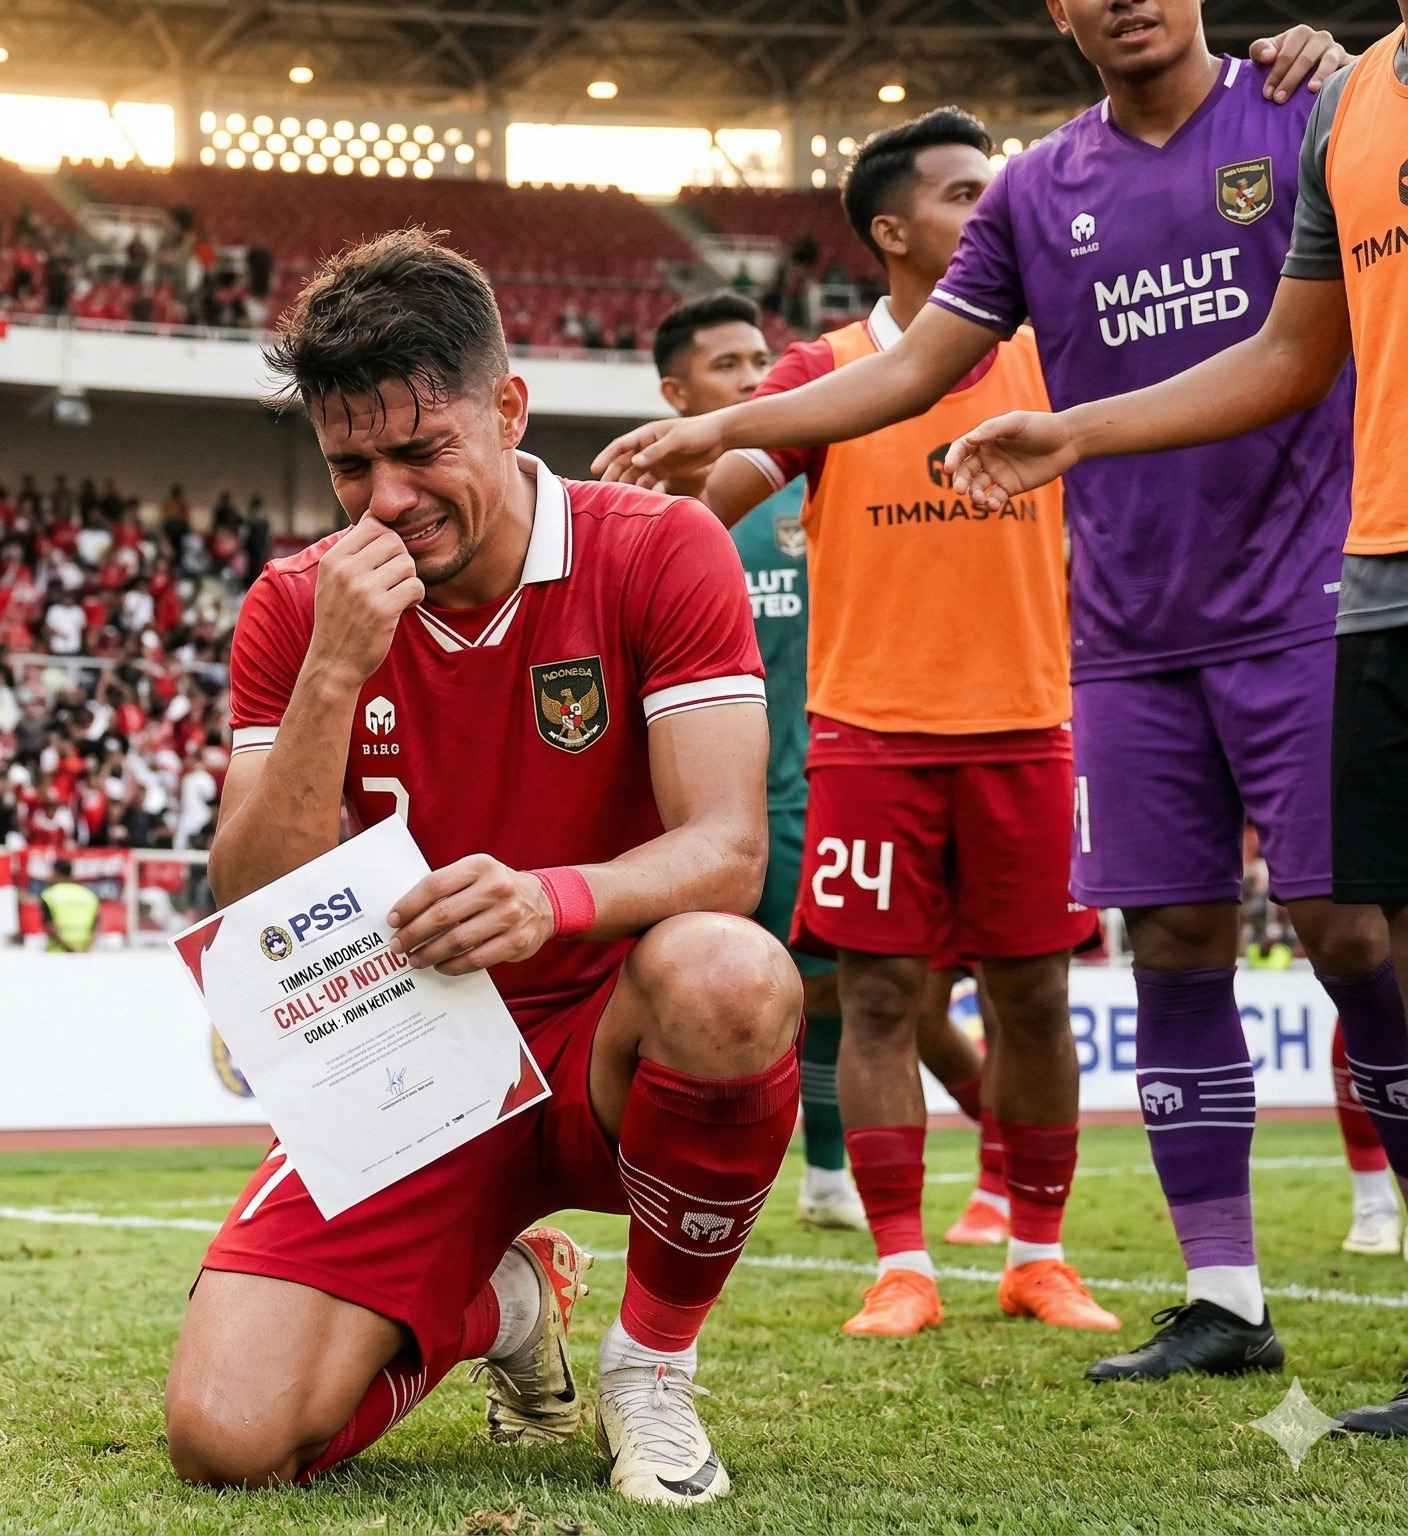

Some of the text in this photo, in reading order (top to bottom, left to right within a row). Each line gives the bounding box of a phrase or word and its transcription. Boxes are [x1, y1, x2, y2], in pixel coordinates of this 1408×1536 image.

[1093, 247, 1240, 312] MALUT
[1099, 286, 1250, 348] UNITED
[811, 836, 894, 911] 24
[288, 886, 363, 943] PSSI
[273, 950, 410, 1030] CALL-UP NOTIC
[278, 962, 325, 994] TIMNAS
[321, 931, 385, 973] INDONESIA
